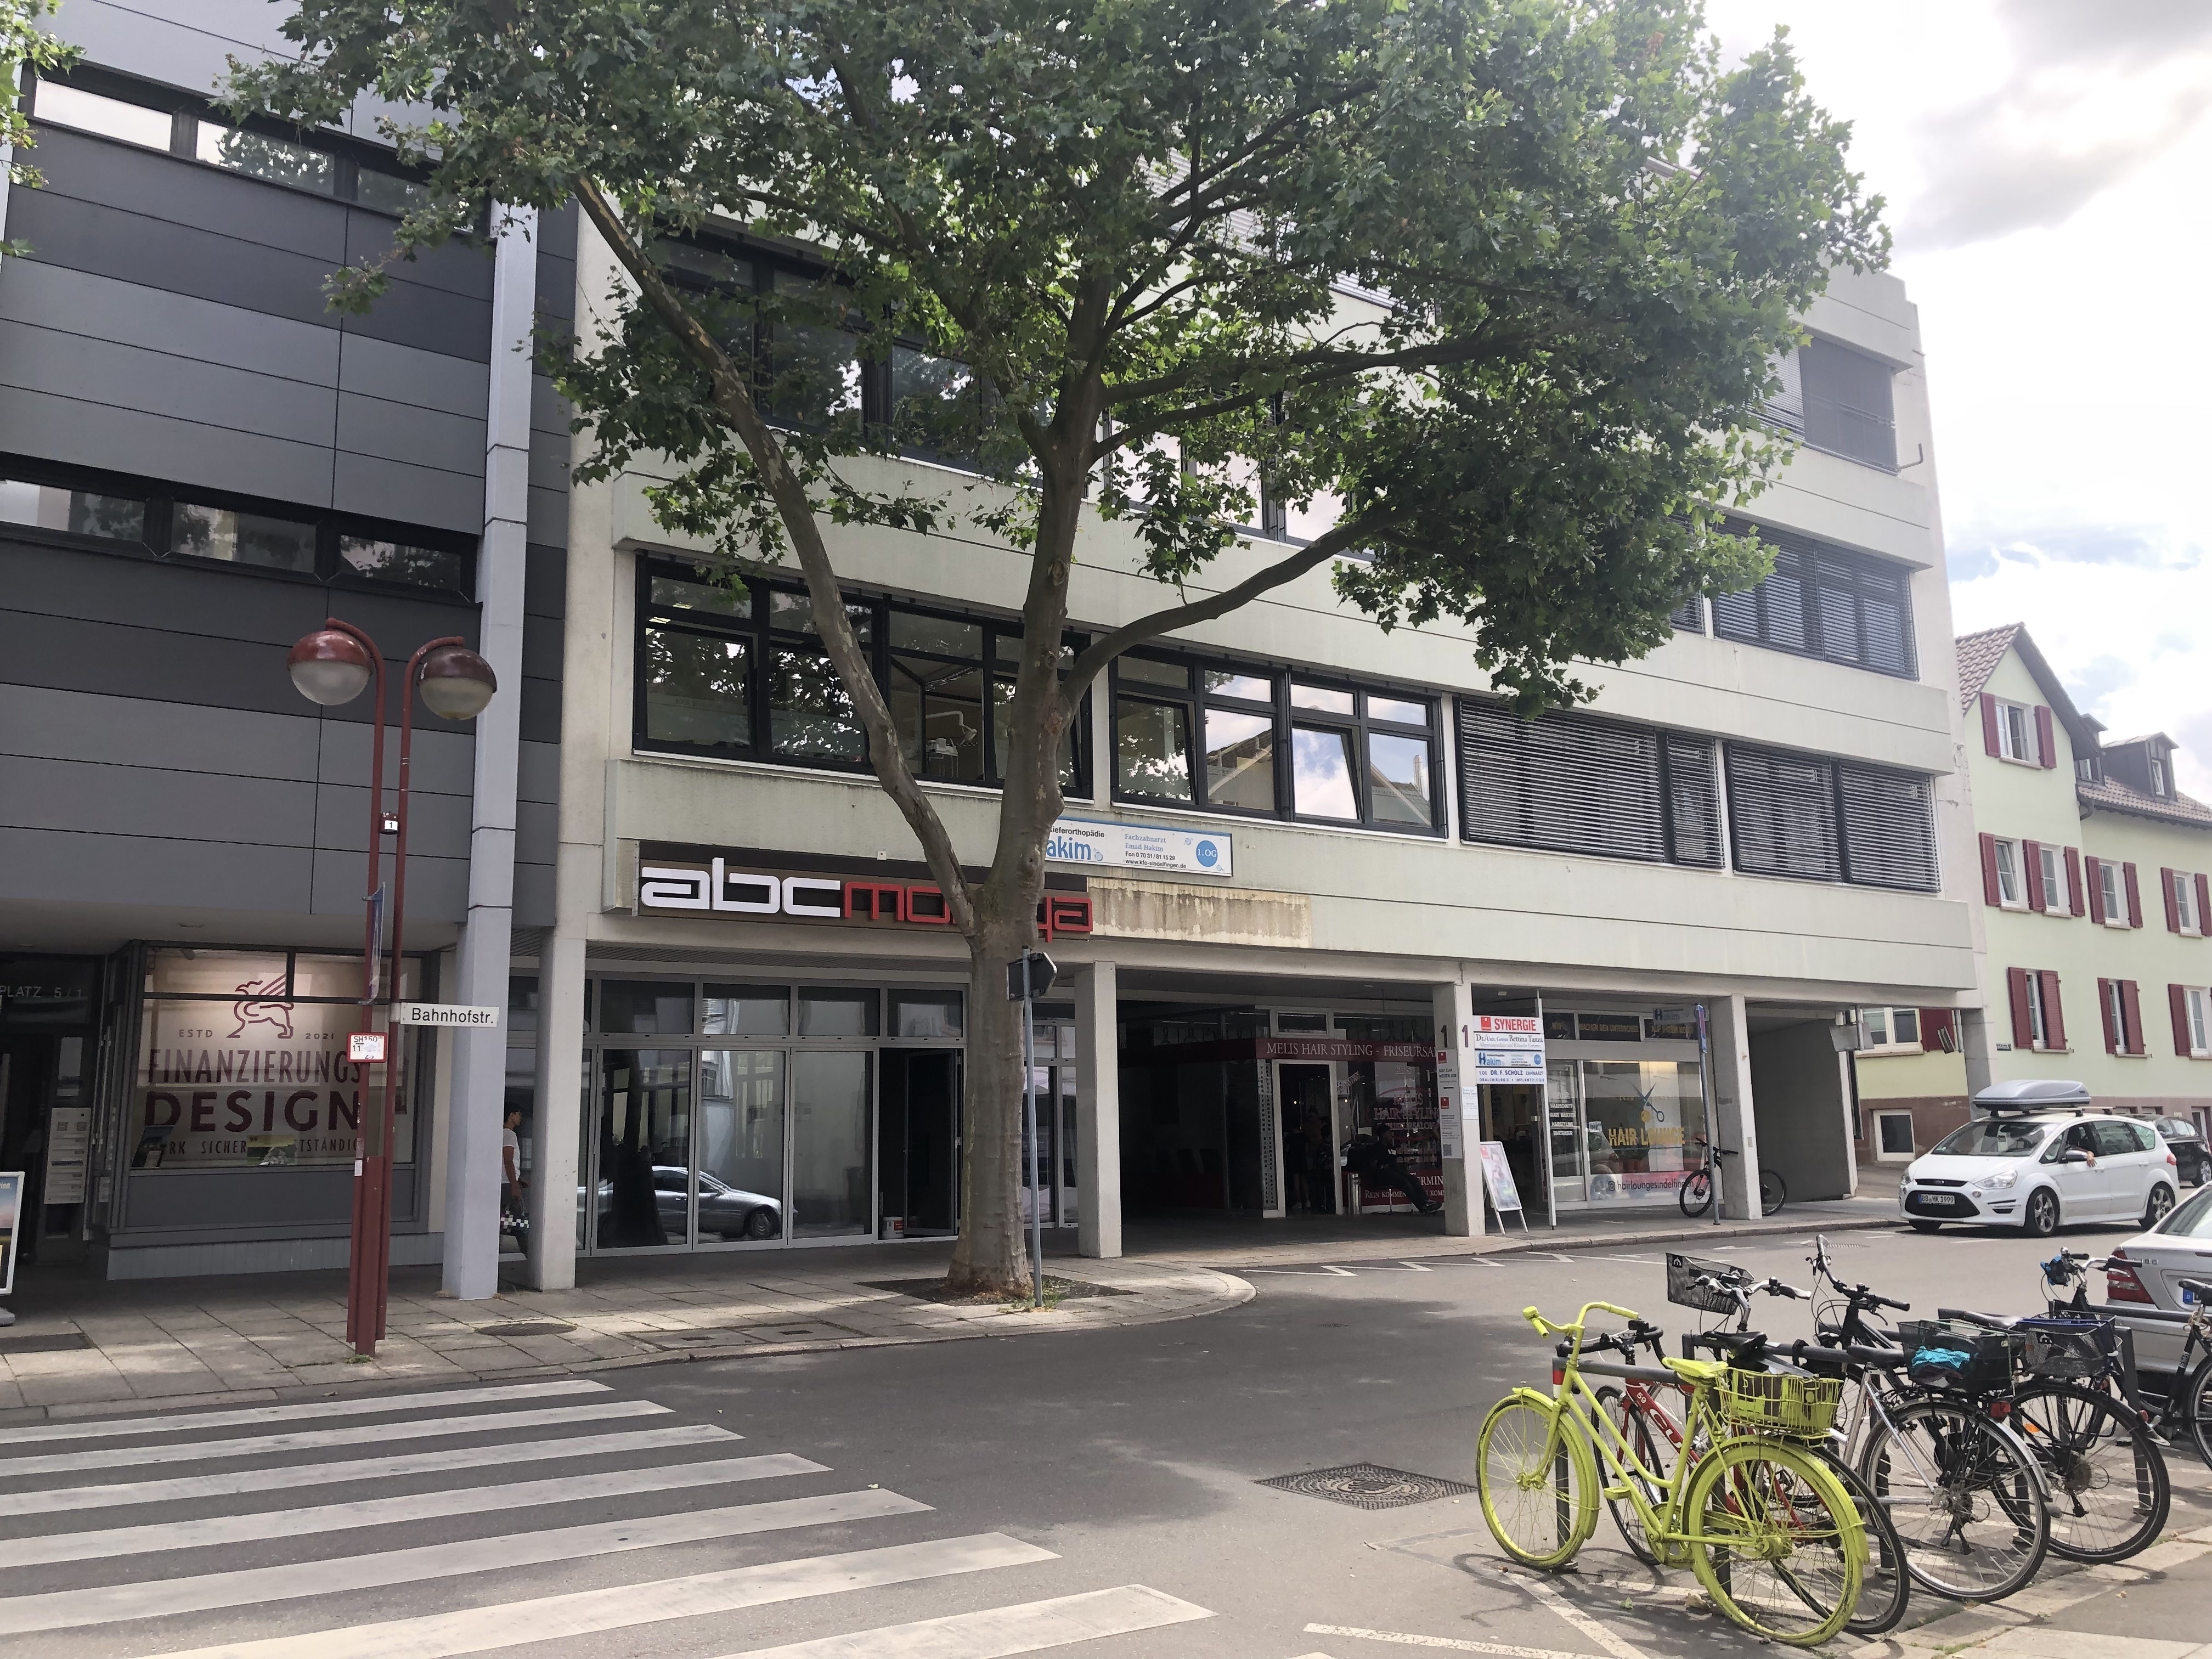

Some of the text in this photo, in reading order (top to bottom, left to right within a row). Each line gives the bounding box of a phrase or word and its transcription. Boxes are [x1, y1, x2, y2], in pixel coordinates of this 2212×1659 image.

[1125, 833, 1166, 843] Fachzahnarzt
[1144, 844, 1164, 852] Hakim
[1197, 849, 1217, 858] 1.OG
[411, 1007, 494, 1024] Bahnhofstr.
[1494, 1018, 1537, 1031] SYNERGIE
[179, 1029, 213, 1037] ESTD
[1441, 1025, 1448, 1048] 1
[1462, 1025, 1469, 1048] 1
[1267, 1042, 1299, 1054] MELIS
[1302, 1043, 1328, 1055] HAIR
[1331, 1044, 1373, 1056] STYLING
[145, 1090, 360, 1132] DESIGN
[1608, 1127, 1685, 1146] HAIR LOUNGE
[201, 1140, 246, 1154] SICHER
